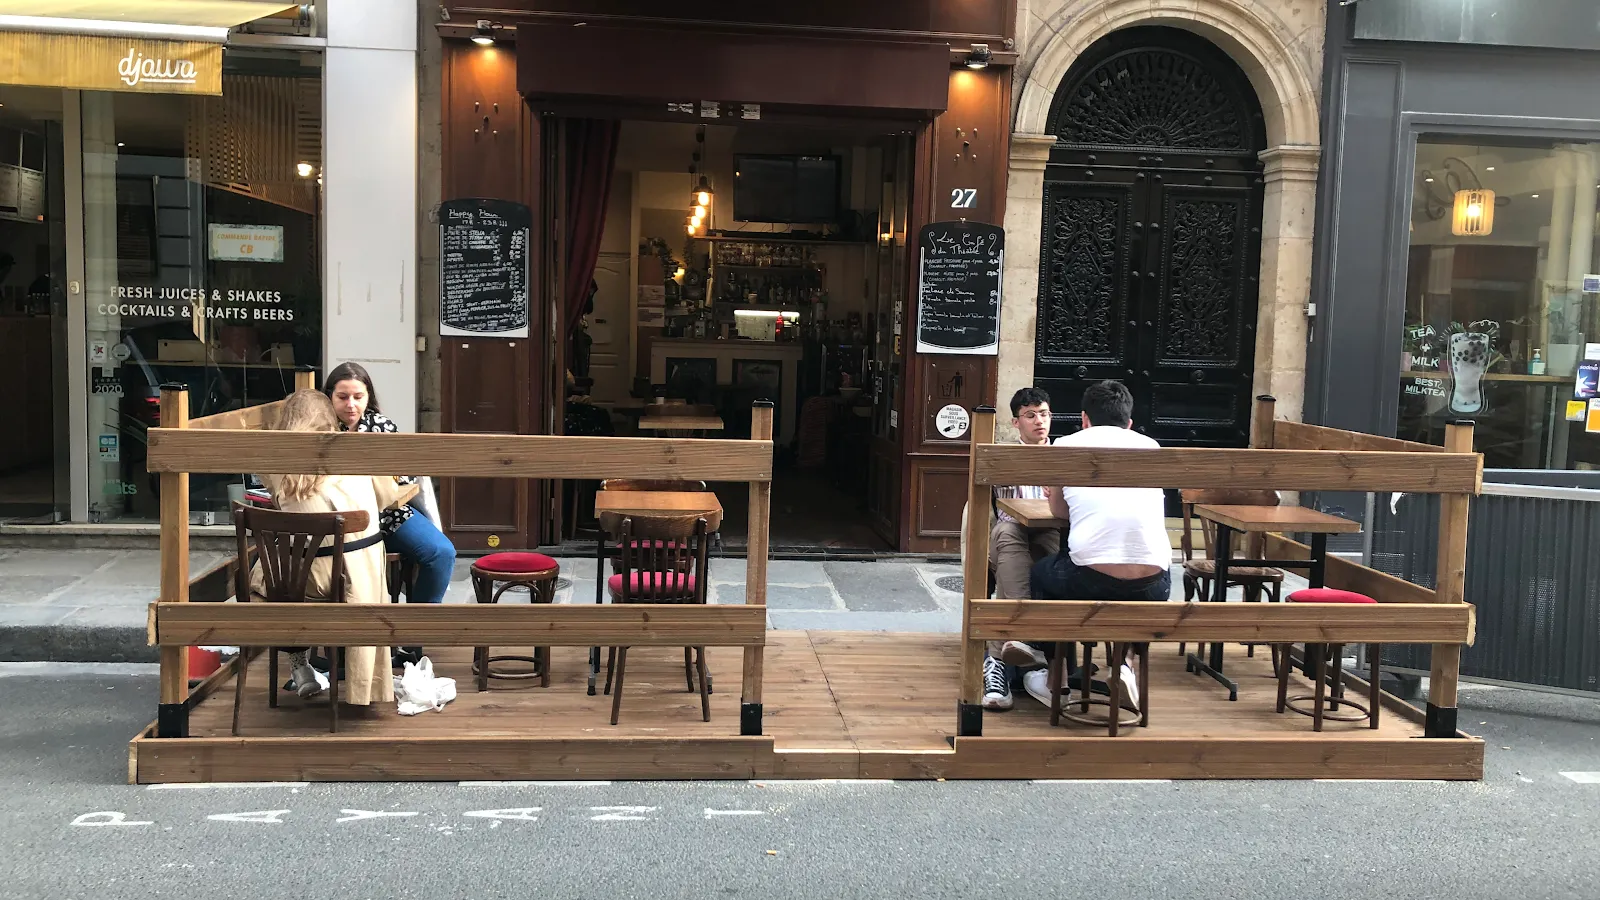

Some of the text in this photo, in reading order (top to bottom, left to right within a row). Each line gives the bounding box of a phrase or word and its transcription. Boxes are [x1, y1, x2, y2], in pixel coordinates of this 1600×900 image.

[118, 47, 198, 86] djawa
[951, 188, 977, 208] 27
[449, 209, 474, 220] Happy
[936, 231, 955, 244] Le
[240, 244, 254, 254] CB
[937, 246, 948, 255] du
[110, 286, 281, 303] FRESH JUICES & SHAKES
[97, 303, 294, 321] COCKTAILS & CRAFTS BEERS
[1410, 326, 1435, 339] TEA
[1411, 355, 1439, 367] MILK
[1414, 377, 1440, 388] BEST
[95, 385, 122, 394] 2020
[1405, 384, 1446, 398] MILKTEA
